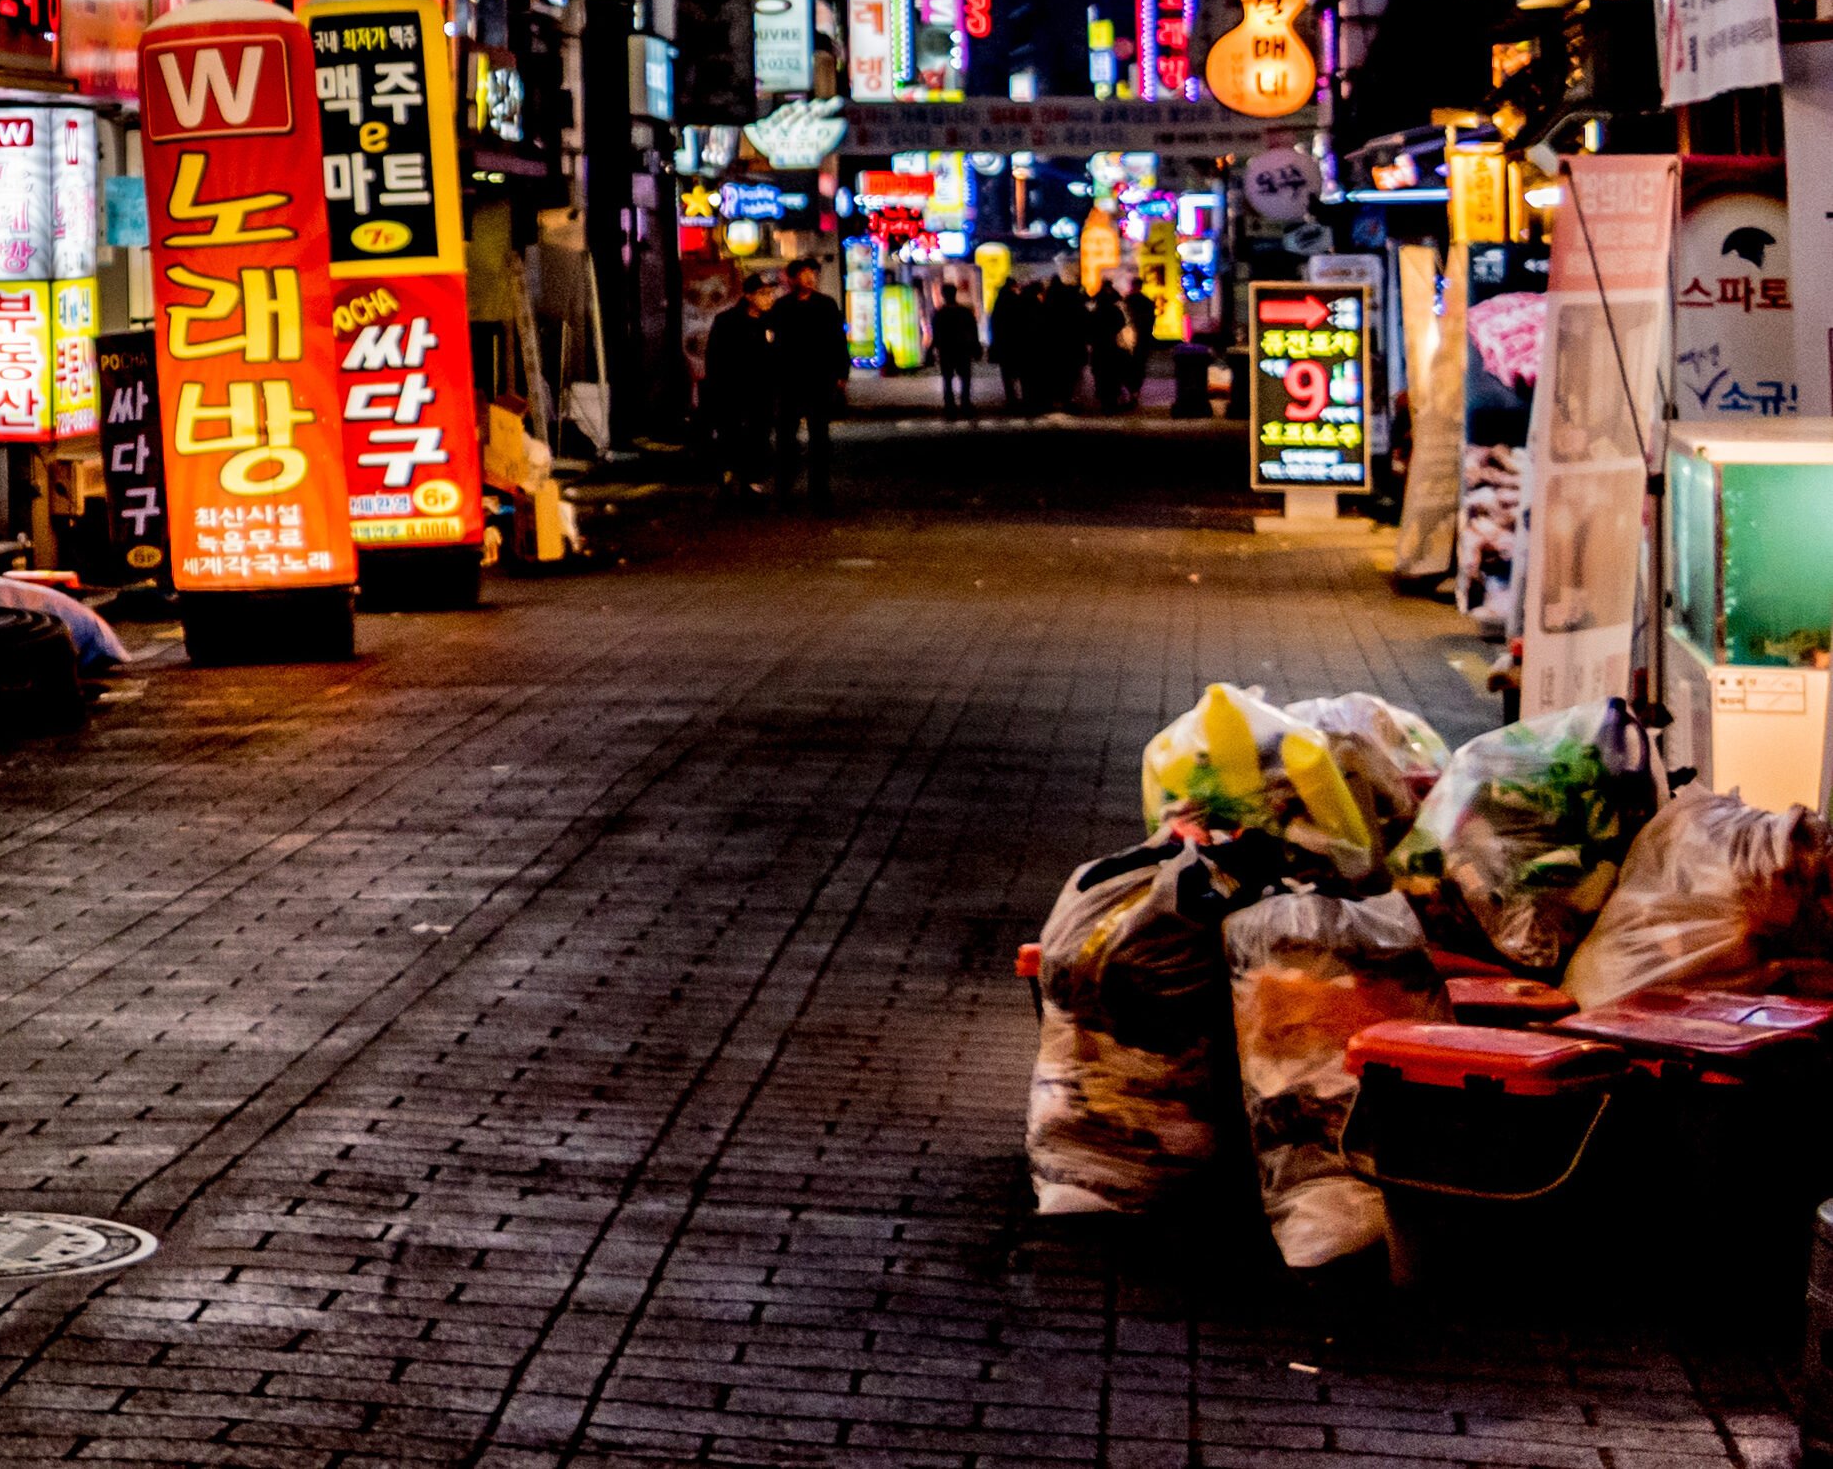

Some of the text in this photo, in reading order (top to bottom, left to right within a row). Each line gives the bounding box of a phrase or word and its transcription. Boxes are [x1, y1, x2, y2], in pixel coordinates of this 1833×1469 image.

[343, 28, 387, 50] 최저가
[159, 46, 263, 130] W
[316, 62, 424, 125] 맥주
[361, 120, 390, 153] e
[323, 153, 432, 212] 마트
[364, 225, 397, 247] 7F
[164, 151, 314, 497] 노래방
[341, 316, 449, 487] 싸다구
[1284, 360, 1329, 422] 9
[108, 380, 161, 536] 싸다구
[194, 506, 301, 528] 최신시설
[422, 488, 451, 506] 6F
[195, 529, 302, 551] 녹음무료
[183, 552, 331, 578] 세계각국노래
